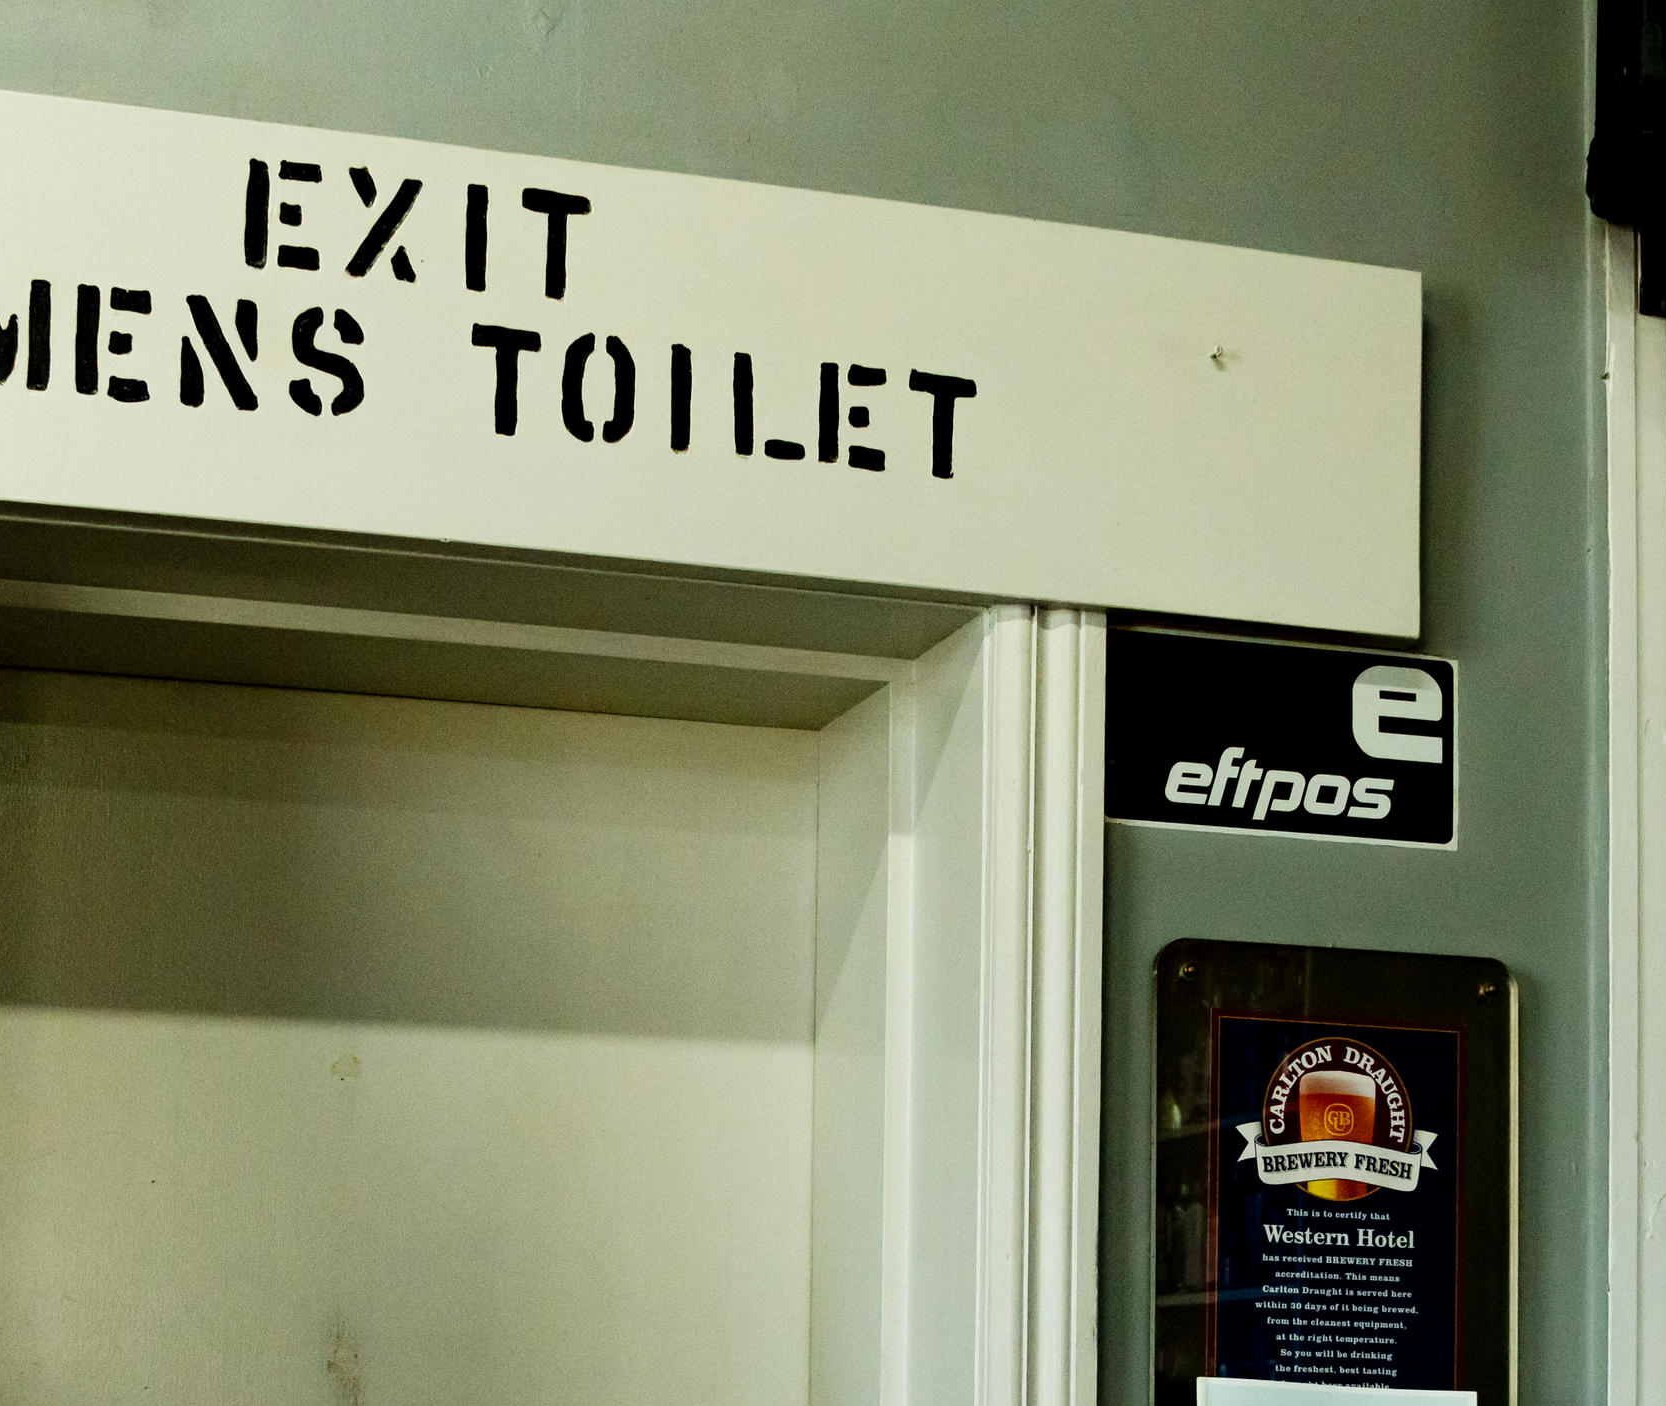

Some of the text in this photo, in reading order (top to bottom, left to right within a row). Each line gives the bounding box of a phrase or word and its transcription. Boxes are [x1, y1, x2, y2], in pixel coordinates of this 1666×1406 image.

[243, 158, 591, 300] EXIT
[471, 323, 977, 479] TOILET
[1352, 665, 1442, 764] e
[1165, 747, 1394, 820] eftpos
[1269, 1045, 1405, 1143] CARLTON DRAUGHT
[1262, 1151, 1413, 1179] BREWERY FRESH
[1263, 1224, 1415, 1249] Western Hotel
[1286, 1208, 1308, 1217] This
[1312, 1209, 1320, 1218] is
[1323, 1210, 1333, 1218] to
[1335, 1211, 1367, 1221] certify
